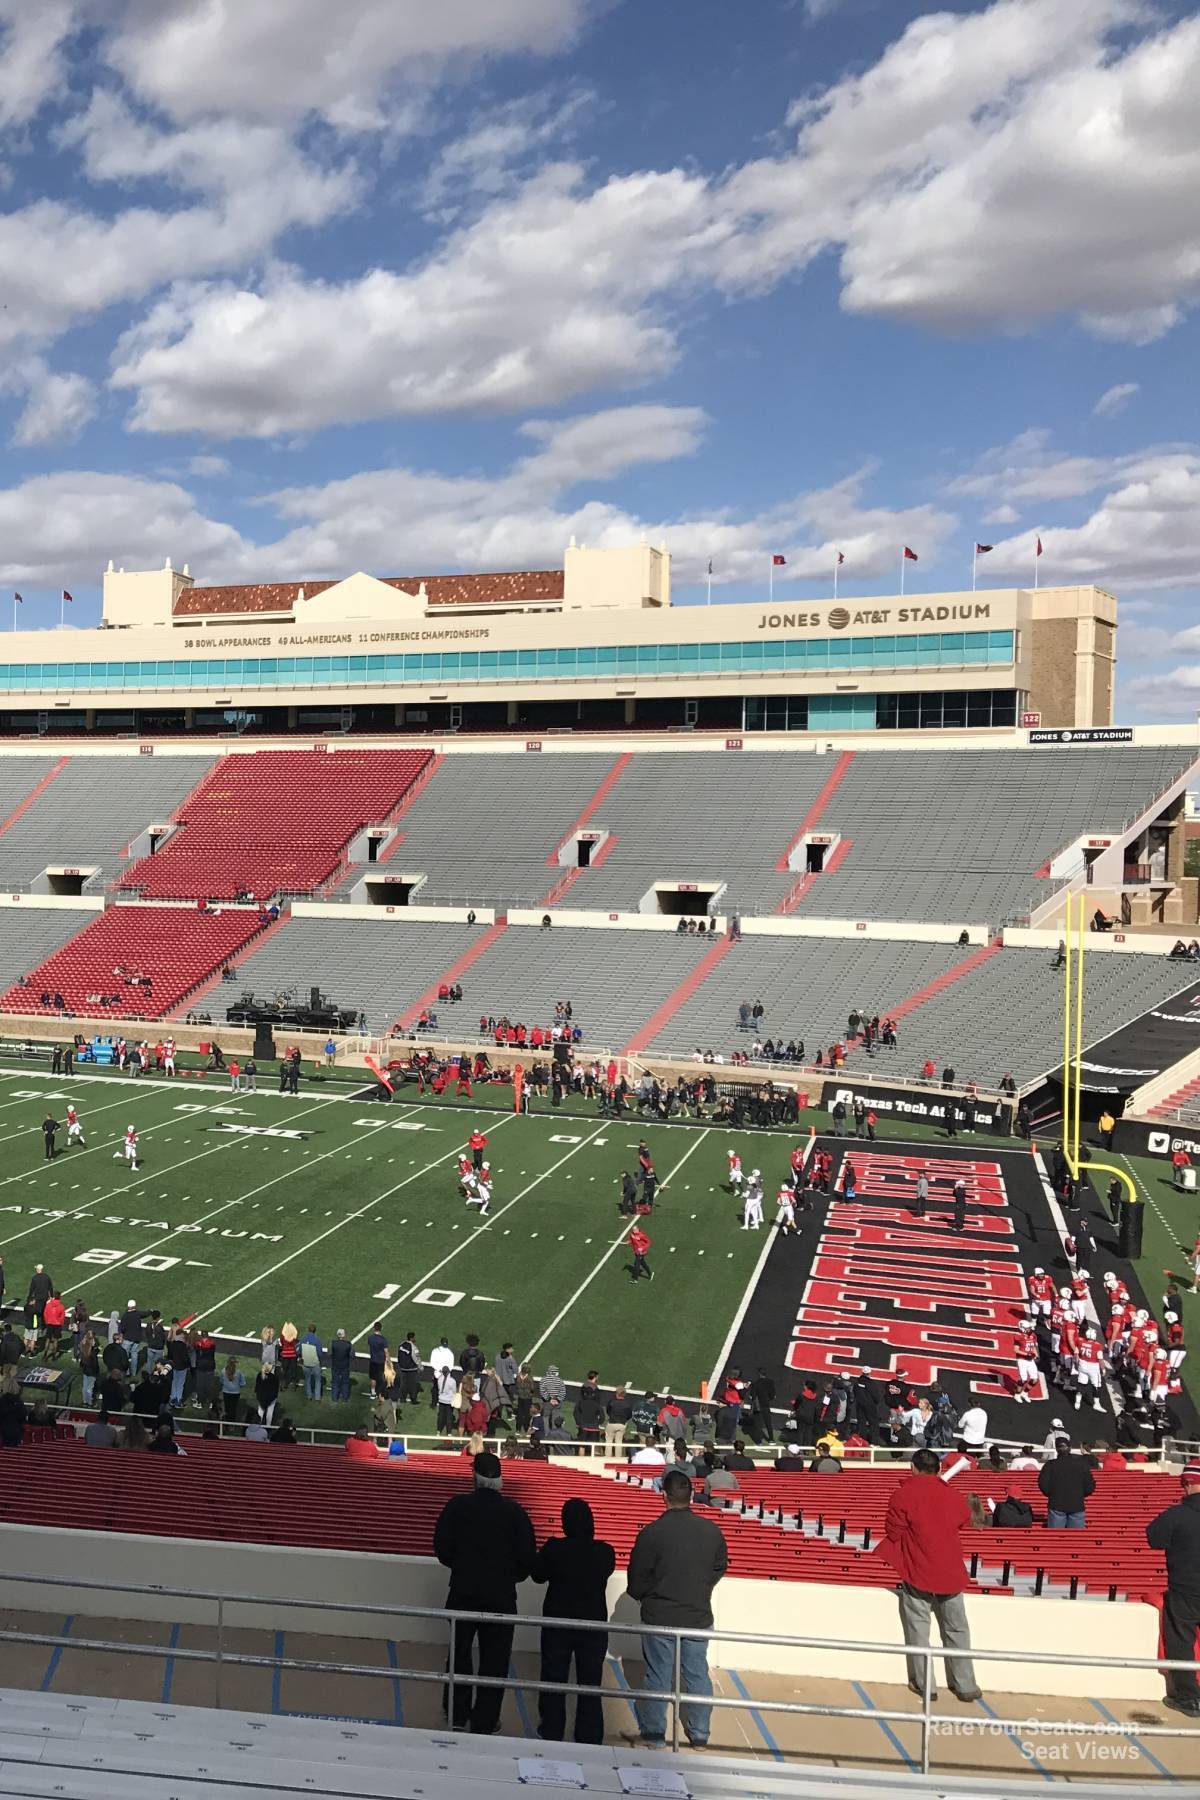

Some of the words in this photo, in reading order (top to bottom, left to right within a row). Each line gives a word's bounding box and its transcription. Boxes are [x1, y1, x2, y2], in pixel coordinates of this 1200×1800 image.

[758, 613, 821, 629] JONES
[853, 609, 891, 624] AT&T
[898, 604, 990, 622] STADIUM
[196, 639, 217, 648] BOWL
[218, 637, 271, 647] APPEARANCES
[289, 634, 352, 645] ALL-AMERICANS
[359, 634, 368, 643] 11
[370, 631, 420, 642] CONFERENCE
[421, 629, 490, 640] CHAMPIONSHIPS
[1031, 733, 1058, 741] JONES
[1072, 732, 1091, 740] AT&T
[1092, 731, 1132, 739] STADIUM
[1070, 1060, 1160, 1076] GEICO
[854, 1095, 893, 1110] Texas
[895, 1100, 928, 1115] Tech
[929, 1105, 993, 1125] Atleics
[100, 1216, 284, 1242] STADIUM
[73, 1248, 182, 1272] 20
[373, 1283, 467, 1308] 10
[1080, 1347, 1092, 1359] 76
